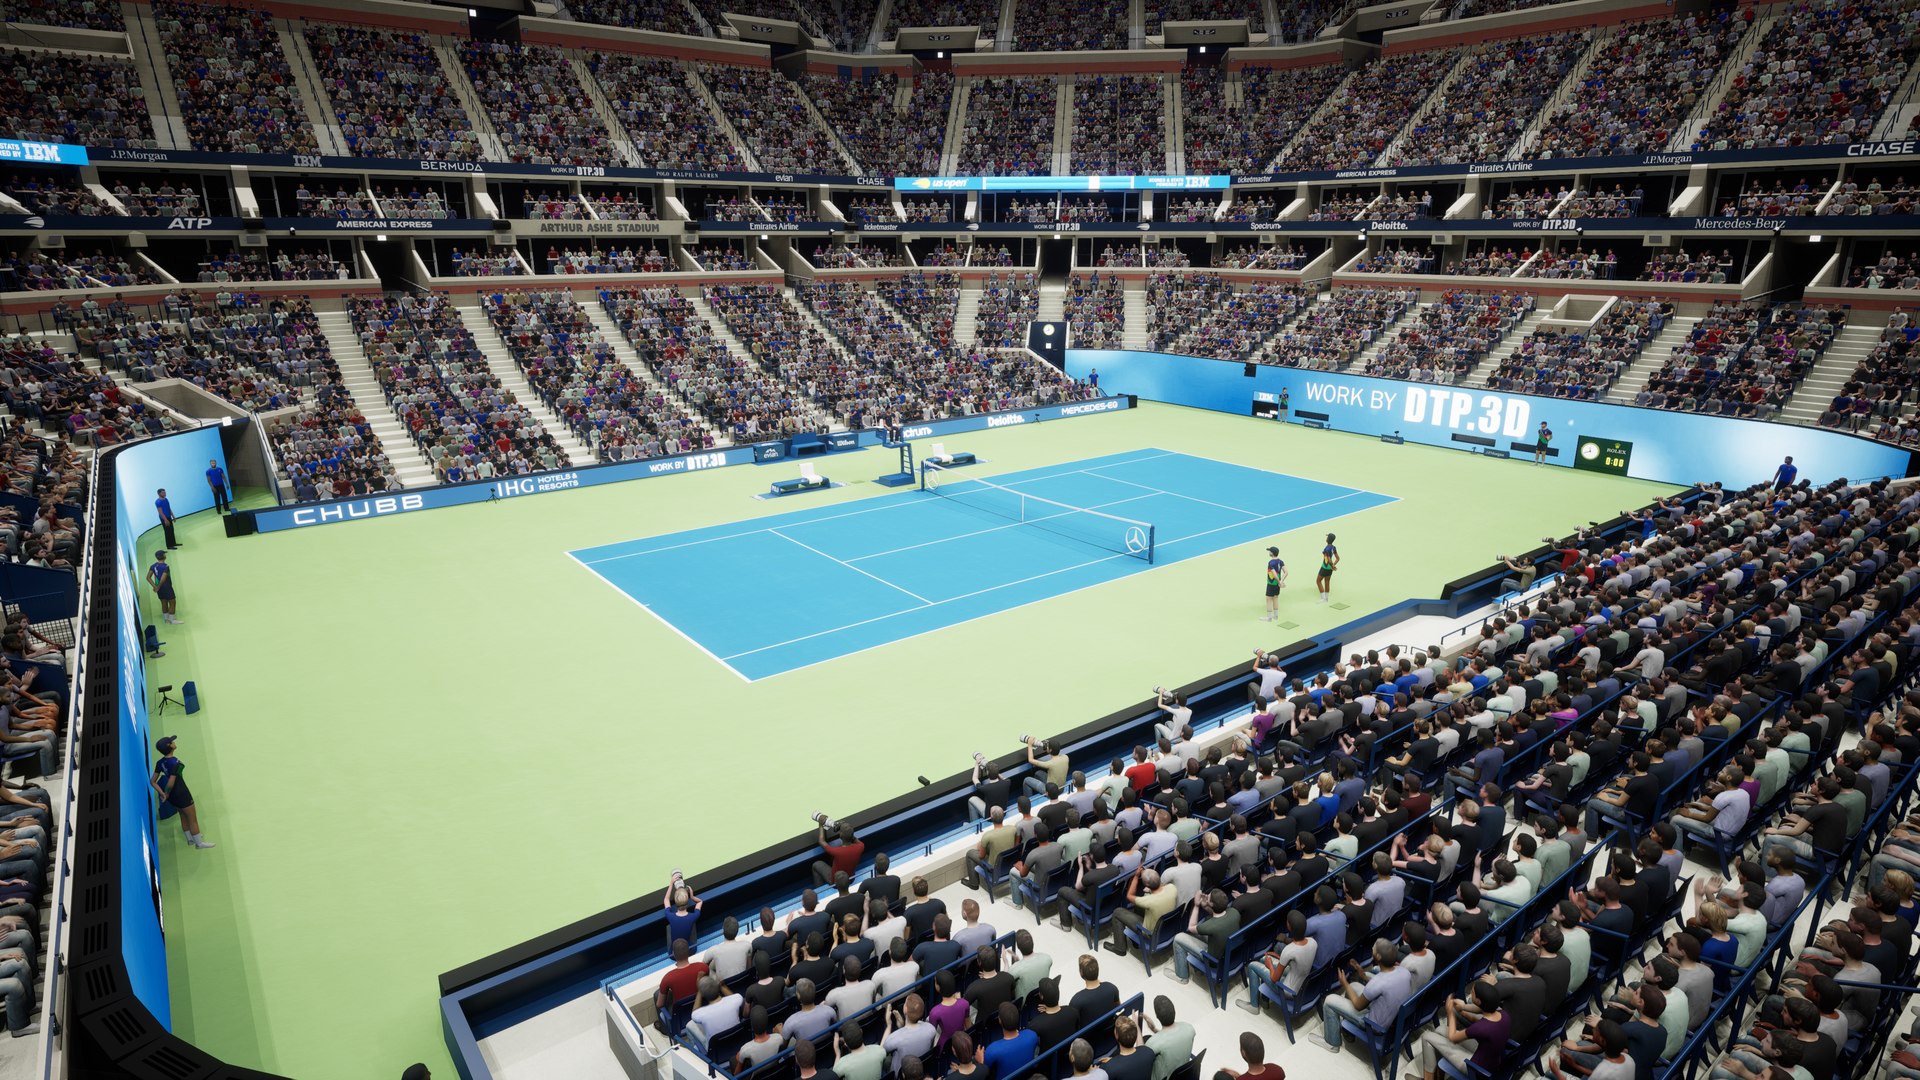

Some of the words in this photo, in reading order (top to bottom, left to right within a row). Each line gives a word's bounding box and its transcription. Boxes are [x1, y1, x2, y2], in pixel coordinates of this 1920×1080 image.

[13, 150, 22, 158] BY
[22, 143, 61, 162] IBM
[1848, 142, 1915, 157] CHASE
[110, 150, 168, 162] J.P.Morgan
[292, 154, 323, 168] IBM
[1642, 155, 1693, 166] J.P.Morgan
[420, 160, 484, 172] BERMUDA
[550, 166, 568, 174] WORK
[576, 165, 605, 177] DTP.3D
[1469, 164, 1502, 174] Emirates
[1504, 162, 1534, 172] Airline
[774, 174, 794, 184] evian
[1237, 175, 1273, 184] ticketmaster
[1335, 169, 1366, 178] AMERICAN
[1368, 169, 1397, 177] EXPRESS
[856, 176, 885, 186] CHASE
[932, 180, 943, 188] us
[943, 179, 968, 190] open
[1185, 176, 1210, 188] IBM
[167, 216, 213, 230] ATP
[335, 220, 388, 229] AMERICAN
[389, 220, 433, 229] EXPRESS
[540, 223, 582, 233] ARTHUR
[586, 223, 614, 233] ASHE
[616, 223, 660, 233] STADIUM
[748, 222, 777, 232] Emirates
[778, 222, 800, 232] Airline
[862, 223, 899, 232] ticketmaster
[1055, 223, 1081, 231] DTP.3D
[1250, 221, 1279, 232] Spectrum
[1371, 220, 1409, 230] Deloitte.
[1541, 218, 1577, 231] DTP.3D
[1693, 218, 1787, 230] Mercedes-Benz
[1061, 401, 1119, 416] MERCEDES-EQ
[1306, 381, 1364, 408] WORK
[1371, 390, 1398, 410] BY
[1404, 386, 1531, 438] DTP.3D
[987, 413, 1025, 427] Deloitte.
[648, 461, 674, 473] WORK
[675, 460, 685, 470] BY
[686, 451, 727, 470] DTP.3D
[1605, 457, 1625, 468] 0:00
[538, 474, 571, 484] HOTELS
[572, 472, 578, 480] &
[497, 479, 536, 498] IHG
[538, 479, 580, 491] RESORTS
[293, 494, 424, 526] CHUBB
